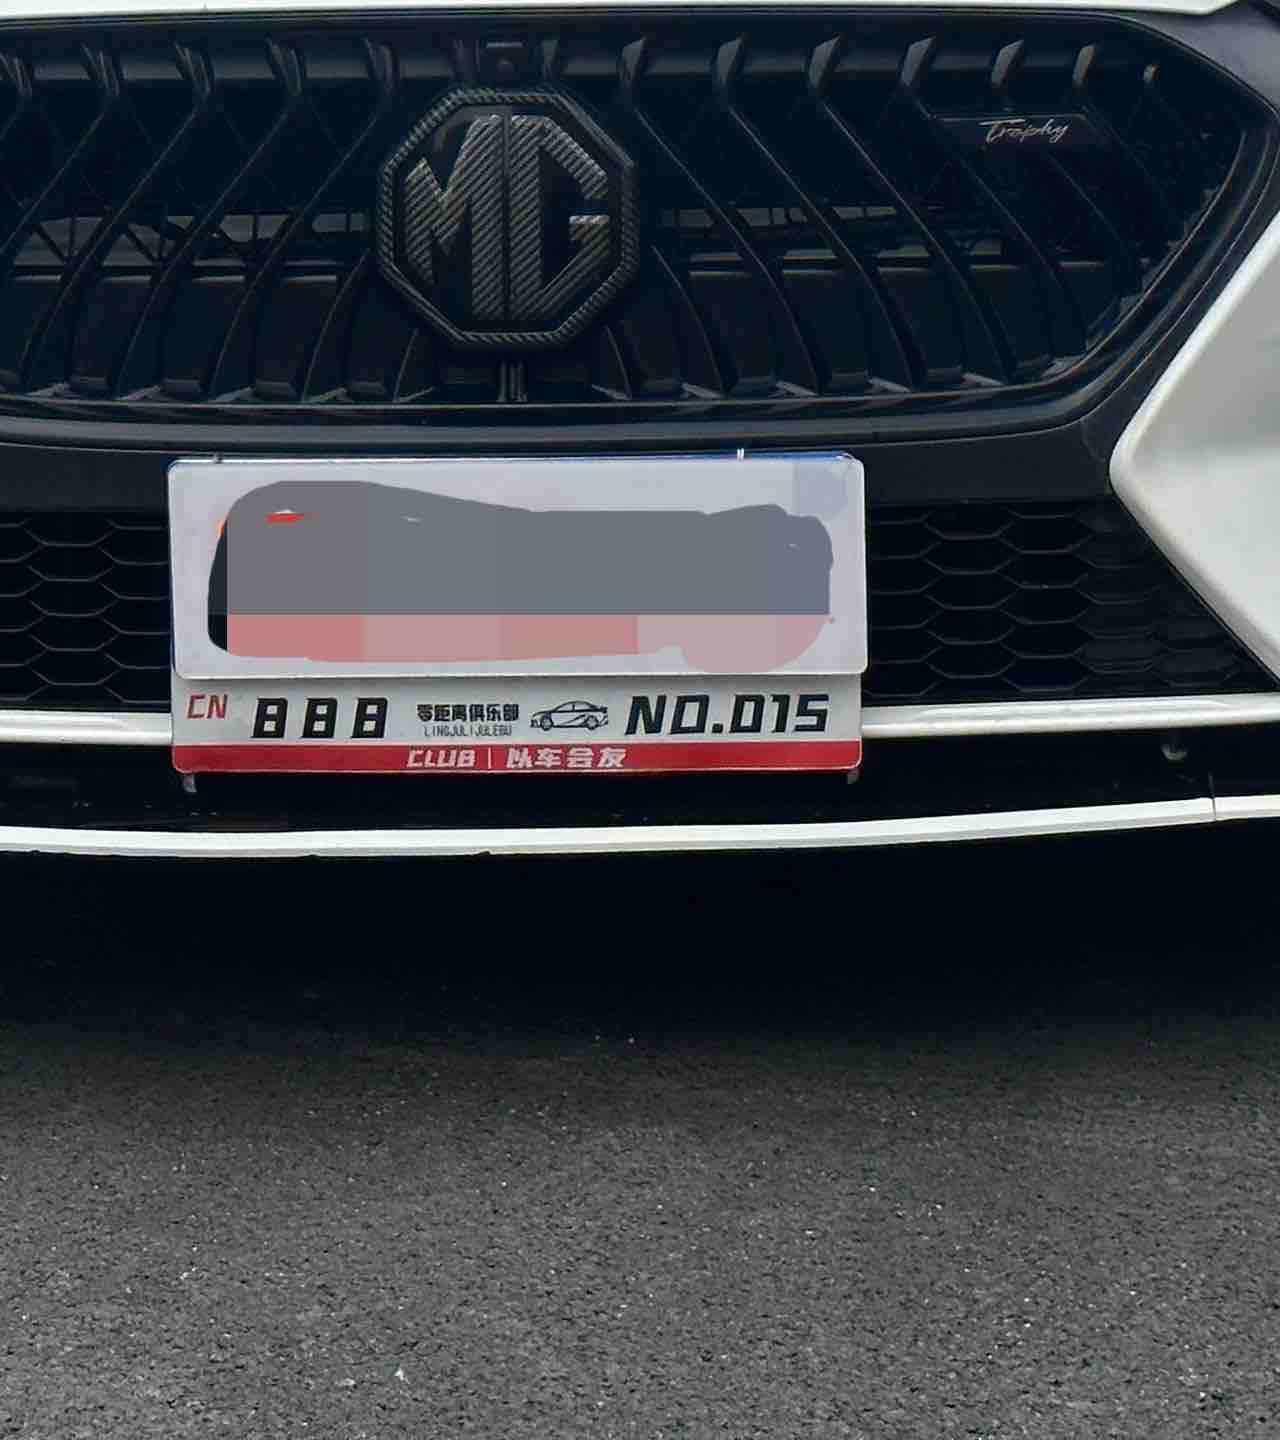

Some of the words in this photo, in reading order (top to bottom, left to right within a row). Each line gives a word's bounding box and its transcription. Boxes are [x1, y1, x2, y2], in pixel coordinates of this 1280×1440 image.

[403, 113, 611, 323] MG
[185, 693, 229, 721] CN
[416, 703, 520, 722] 零距离俱乐部
[624, 693, 830, 736] NO.015
[405, 747, 476, 770] CLUB
[503, 746, 626, 771] 以车会友
